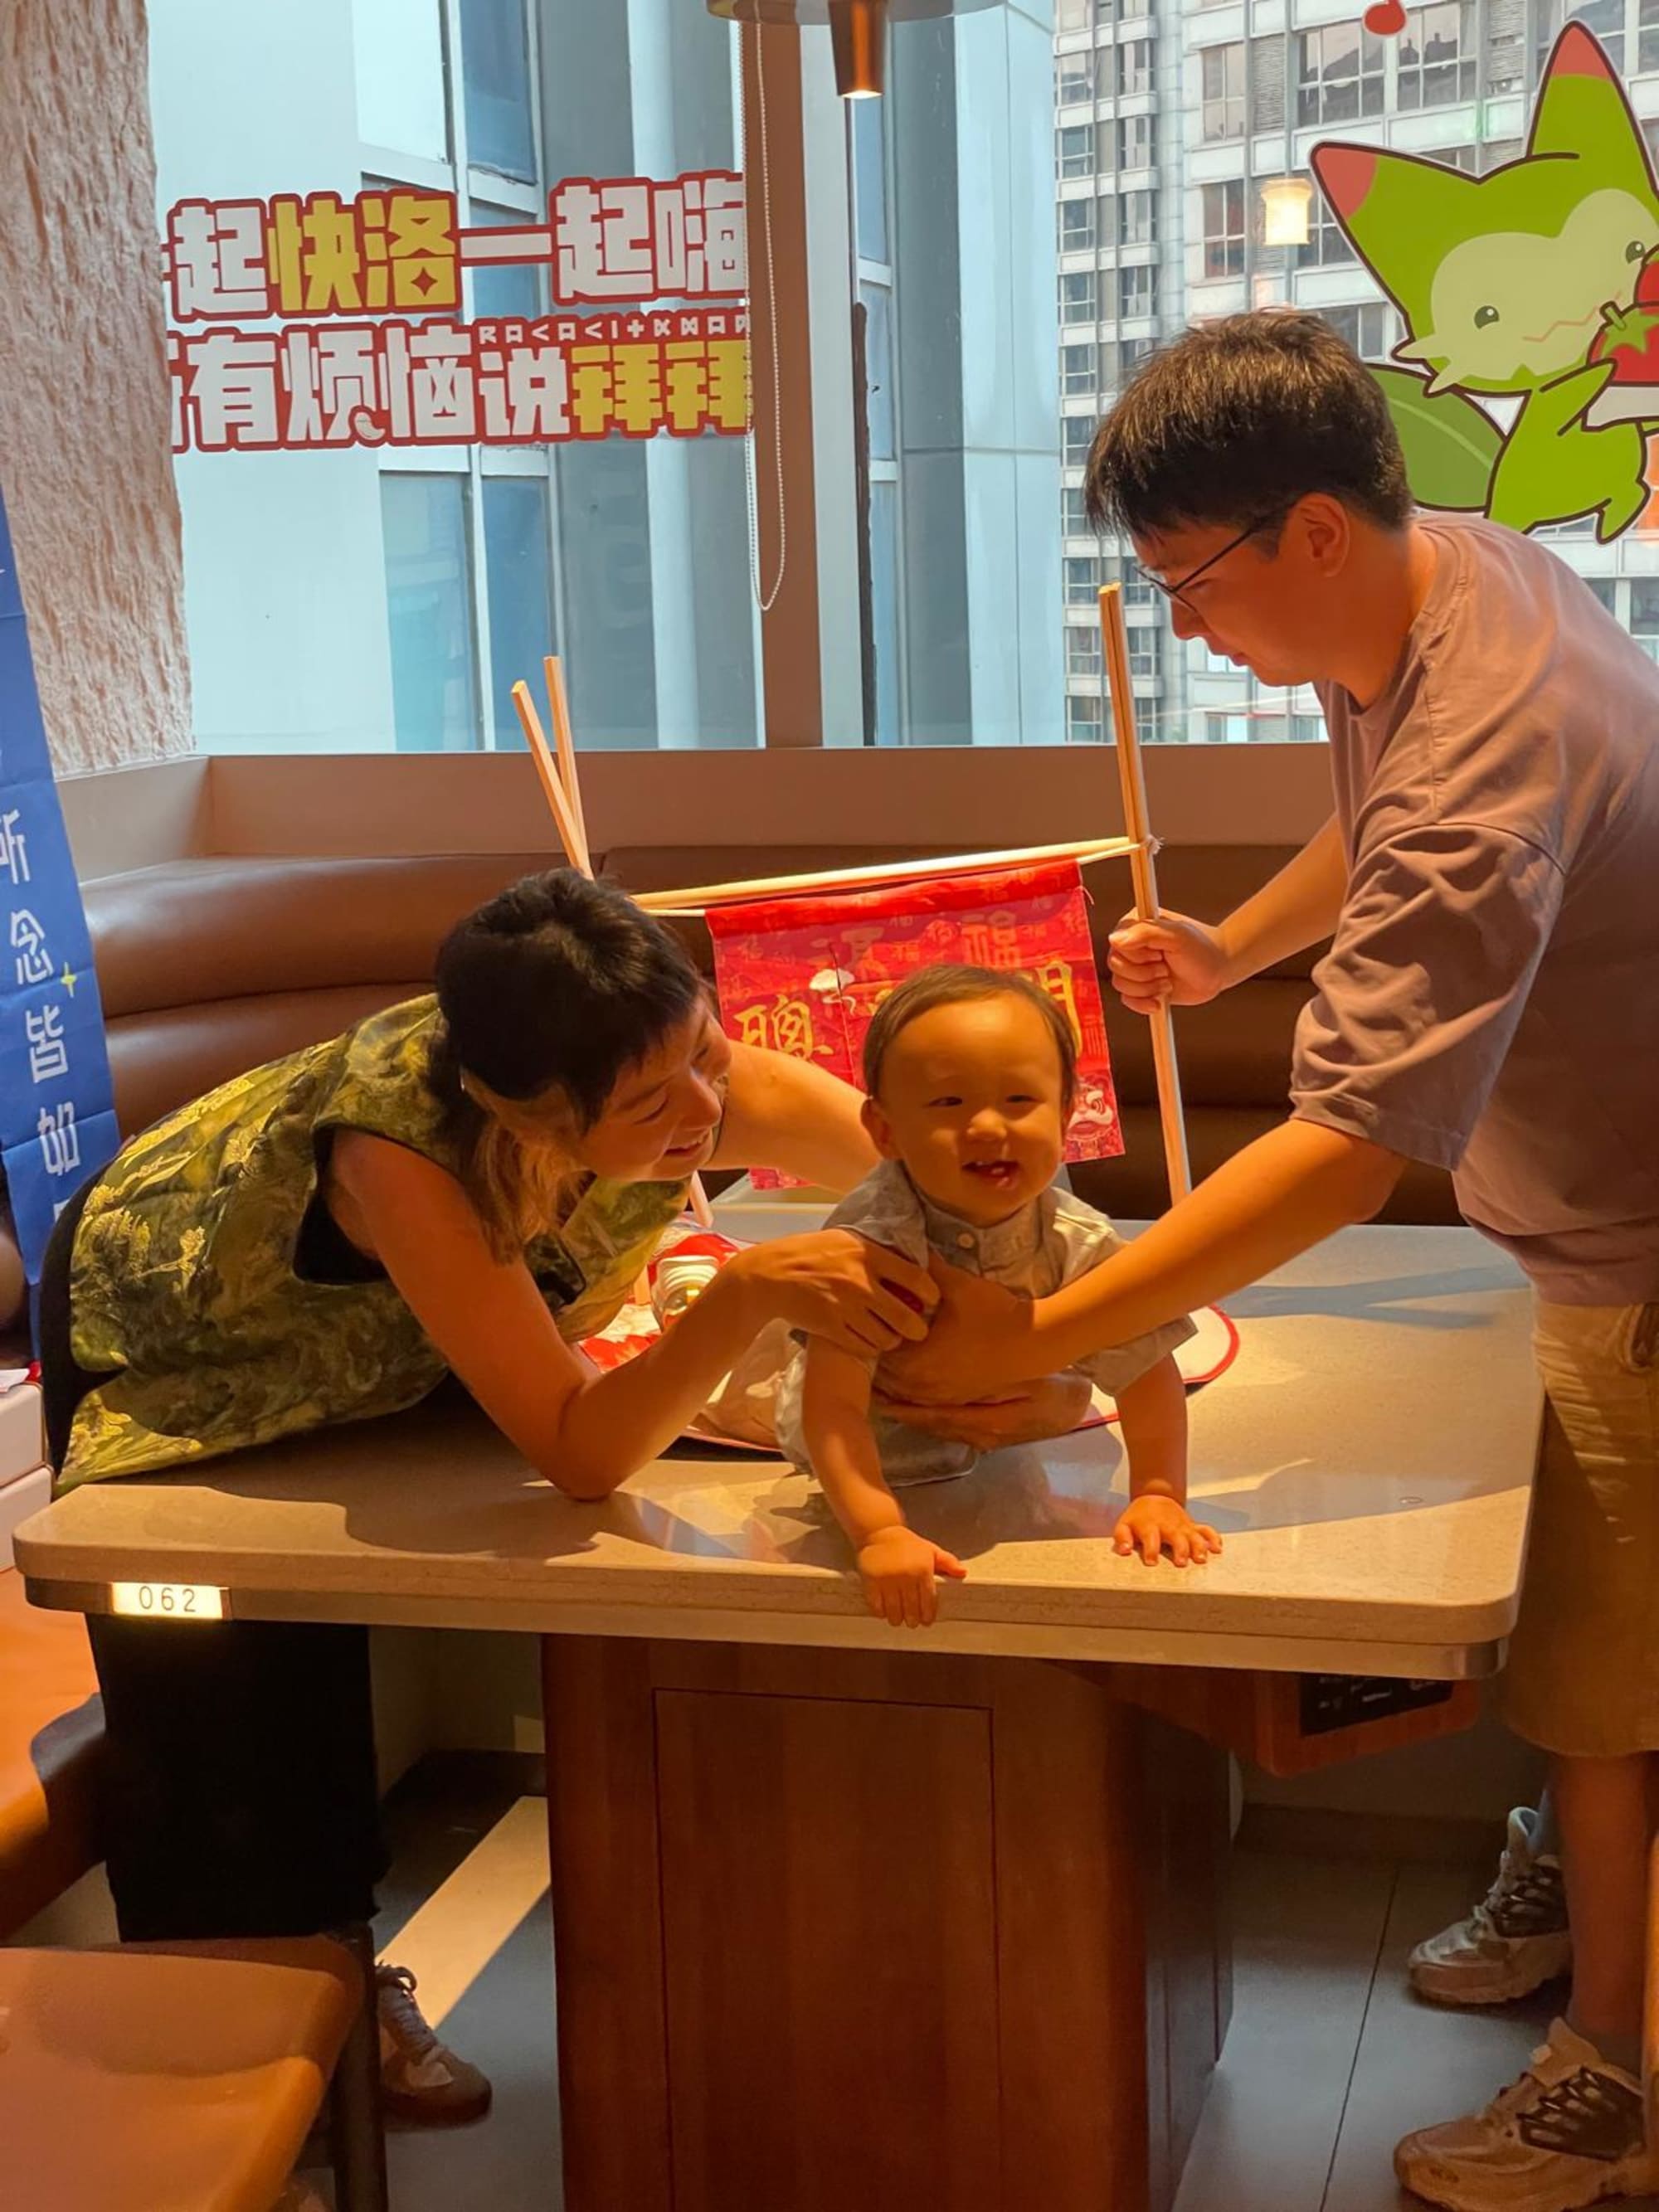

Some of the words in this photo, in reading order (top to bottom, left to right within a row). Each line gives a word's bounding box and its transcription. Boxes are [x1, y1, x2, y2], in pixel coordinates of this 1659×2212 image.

[162, 174, 746, 317] 起快洛一起嗨
[139, 1585, 197, 1612] 062
